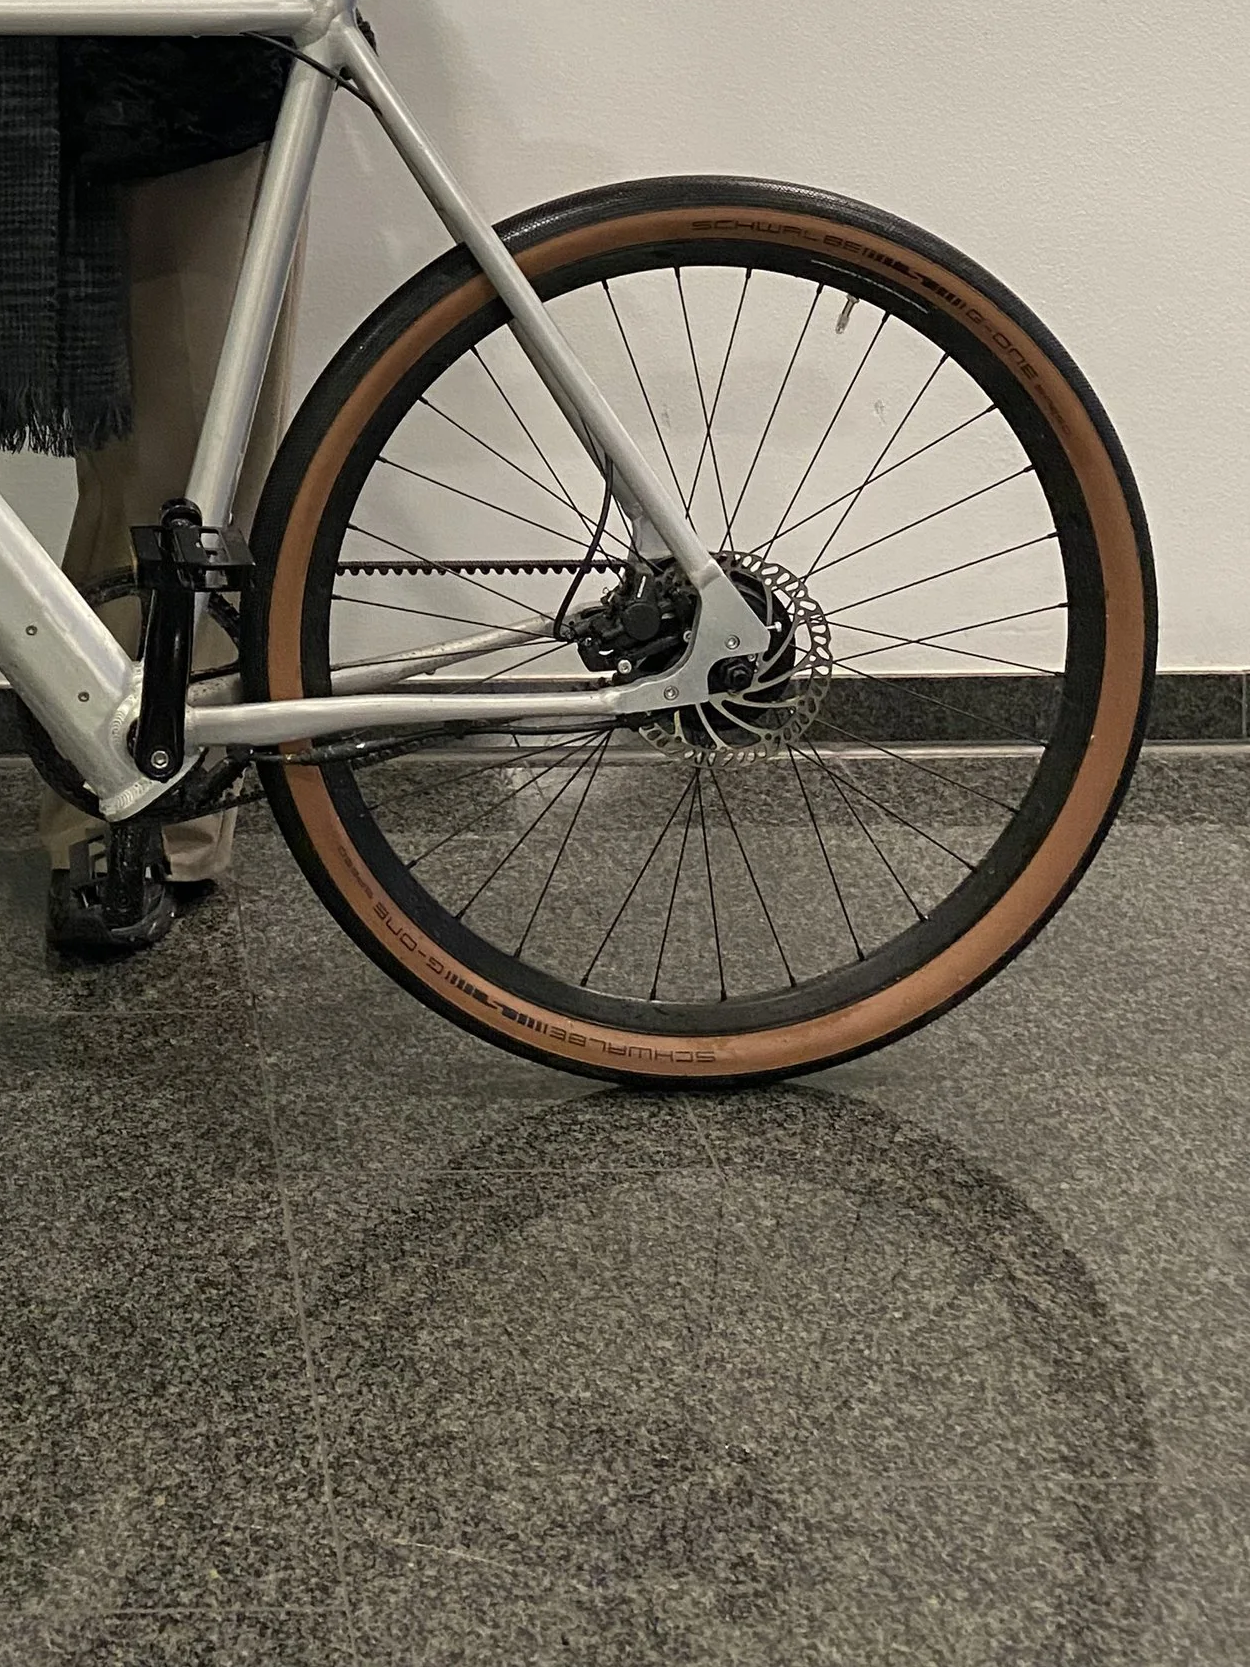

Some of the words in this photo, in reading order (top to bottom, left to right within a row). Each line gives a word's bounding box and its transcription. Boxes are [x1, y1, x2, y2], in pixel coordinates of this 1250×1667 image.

[691, 219, 862, 256] SCHWALBE
[965, 307, 1040, 380] G-ONE
[372, 901, 446, 975] G-ONE
[549, 1027, 717, 1065] SCHWALBE
